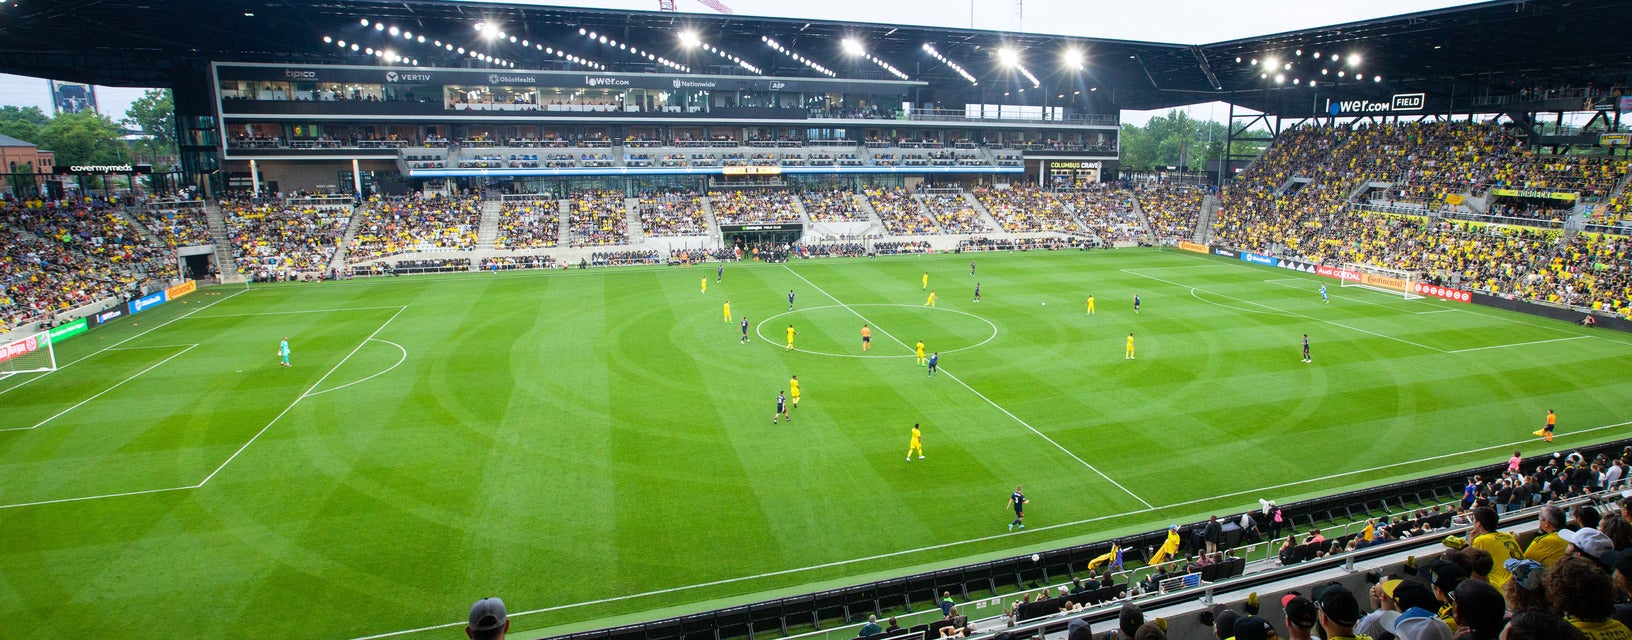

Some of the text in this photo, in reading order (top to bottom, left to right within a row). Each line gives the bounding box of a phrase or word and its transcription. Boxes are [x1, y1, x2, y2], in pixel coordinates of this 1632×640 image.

[681, 80, 716, 88] Nationwide
[1396, 97, 1420, 107] FIELD
[70, 163, 133, 173] covermymeds
[1050, 161, 1080, 169] COLUMBUS
[1318, 267, 1333, 275] Audi
[1367, 275, 1403, 288] Continental
[1503, 540, 1525, 561] 8
